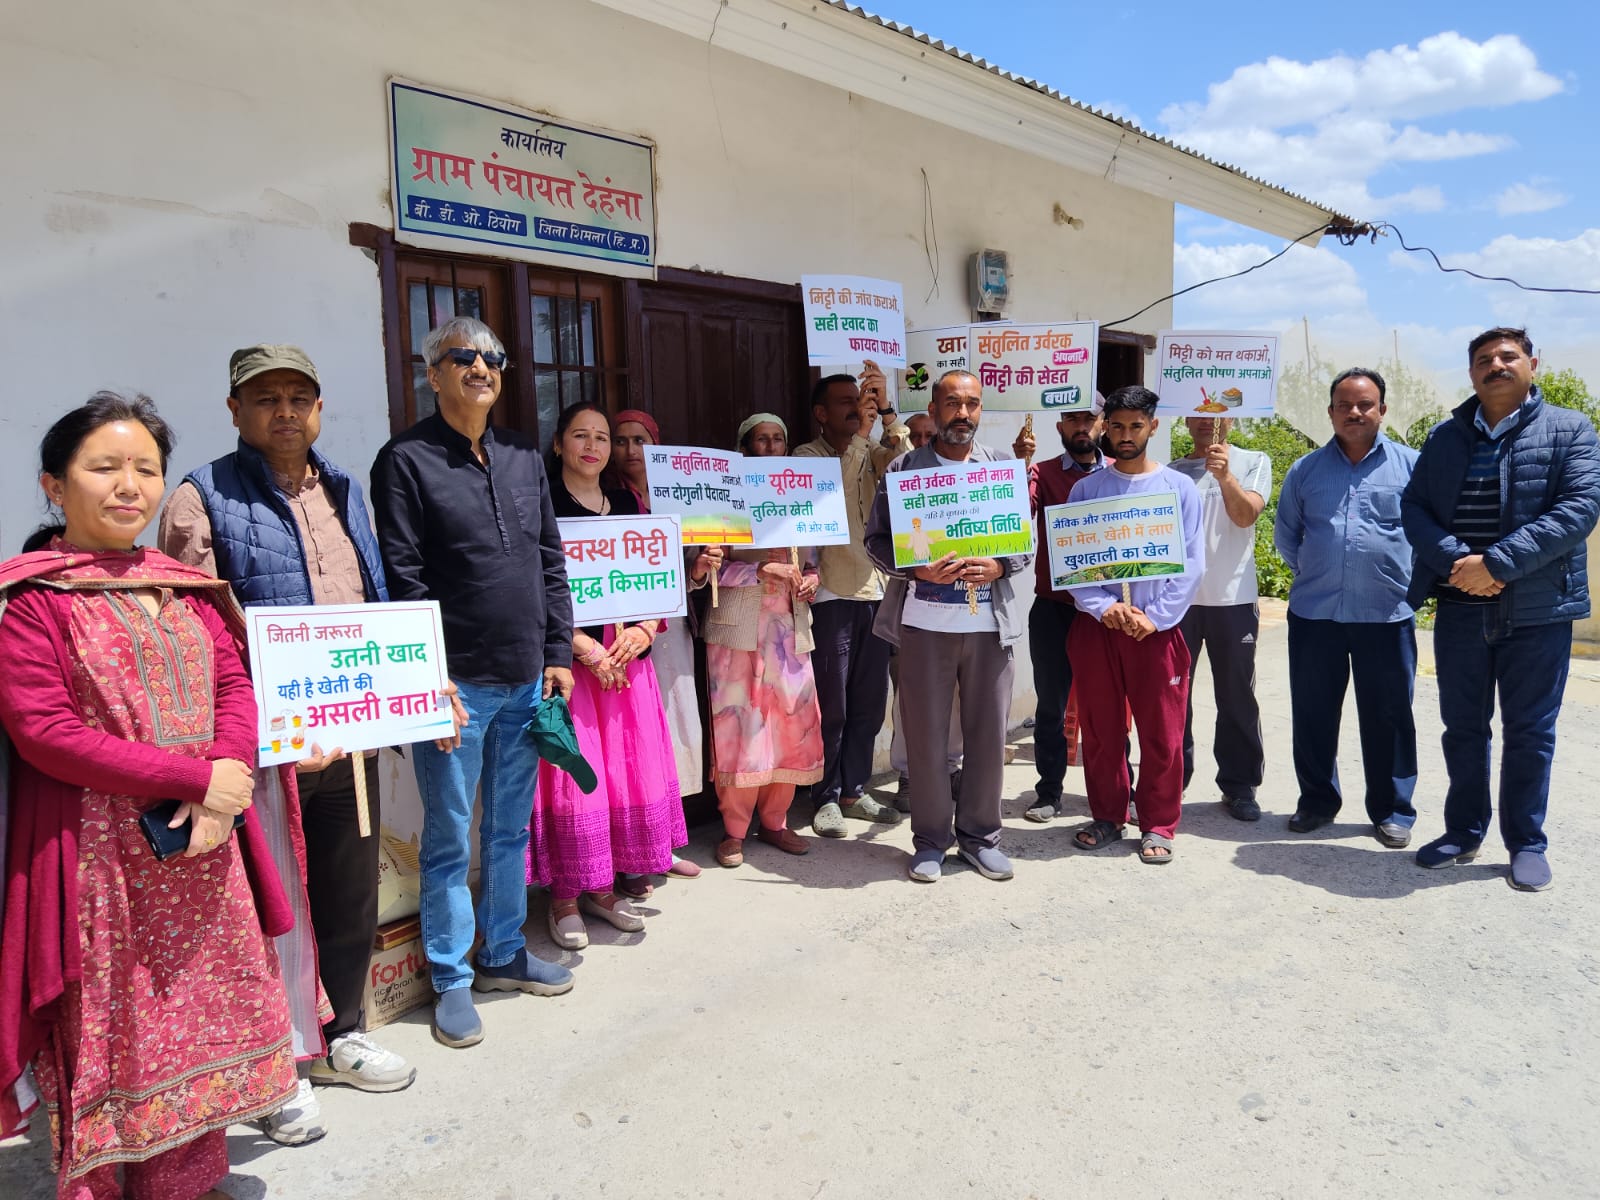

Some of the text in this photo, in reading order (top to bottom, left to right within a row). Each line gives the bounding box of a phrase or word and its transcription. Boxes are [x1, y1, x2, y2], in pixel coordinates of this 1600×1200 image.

[501, 127, 567, 160] कार्यालय
[411, 147, 643, 221] ग्राम पंचायत देहंना
[488, 211, 521, 233] ठियोग
[538, 221, 567, 238] जिला
[809, 288, 835, 310] मिट्टी
[837, 288, 852, 304] की
[854, 289, 872, 307] जांच
[814, 312, 879, 333] सही खाद का
[849, 337, 901, 357] फायदा पाओ!
[977, 328, 1073, 359] संतुलित उर्वरक
[1169, 343, 1193, 363] मिट्टी
[1196, 346, 1212, 361] को
[1215, 350, 1233, 361] मत
[936, 356, 966, 368] का सही
[1163, 365, 1272, 382] संतुलित पोषण अपनाओ
[979, 361, 1070, 393] मिट्टी की सेहत
[1044, 385, 1079, 404] बचाएं
[651, 451, 730, 476] आज संतुलित खाद
[768, 468, 813, 495] यूरिया
[898, 474, 921, 492] सही
[924, 472, 957, 490] उर्वरक
[966, 467, 988, 484] सही
[990, 468, 1015, 482] मात्रा
[653, 482, 731, 506] कल दोगुनी पैदावार
[902, 493, 926, 510] सही
[928, 492, 959, 507] समय
[968, 486, 990, 502] सही
[991, 483, 1014, 500] विधि
[789, 500, 813, 516] खेती
[1052, 505, 1174, 530] जैविक और रासायनिक खाद
[796, 521, 807, 534] की
[809, 521, 822, 533] ओर
[946, 513, 1021, 538] भविष्य निधि
[1056, 535, 1073, 548] का
[1076, 531, 1101, 545] मेल,
[1104, 525, 1131, 541] खेती
[1134, 523, 1145, 537] में
[622, 528, 668, 566] मिट्टी
[1064, 542, 1169, 570] खुशहाली का खेल
[608, 569, 676, 594] किसान!
[266, 622, 363, 644] जितनी जरूरत
[329, 640, 427, 669] उतनी खाद
[278, 672, 373, 700] यही है खेती की
[307, 689, 439, 728] असली बात!
[393, 977, 413, 990] bran
